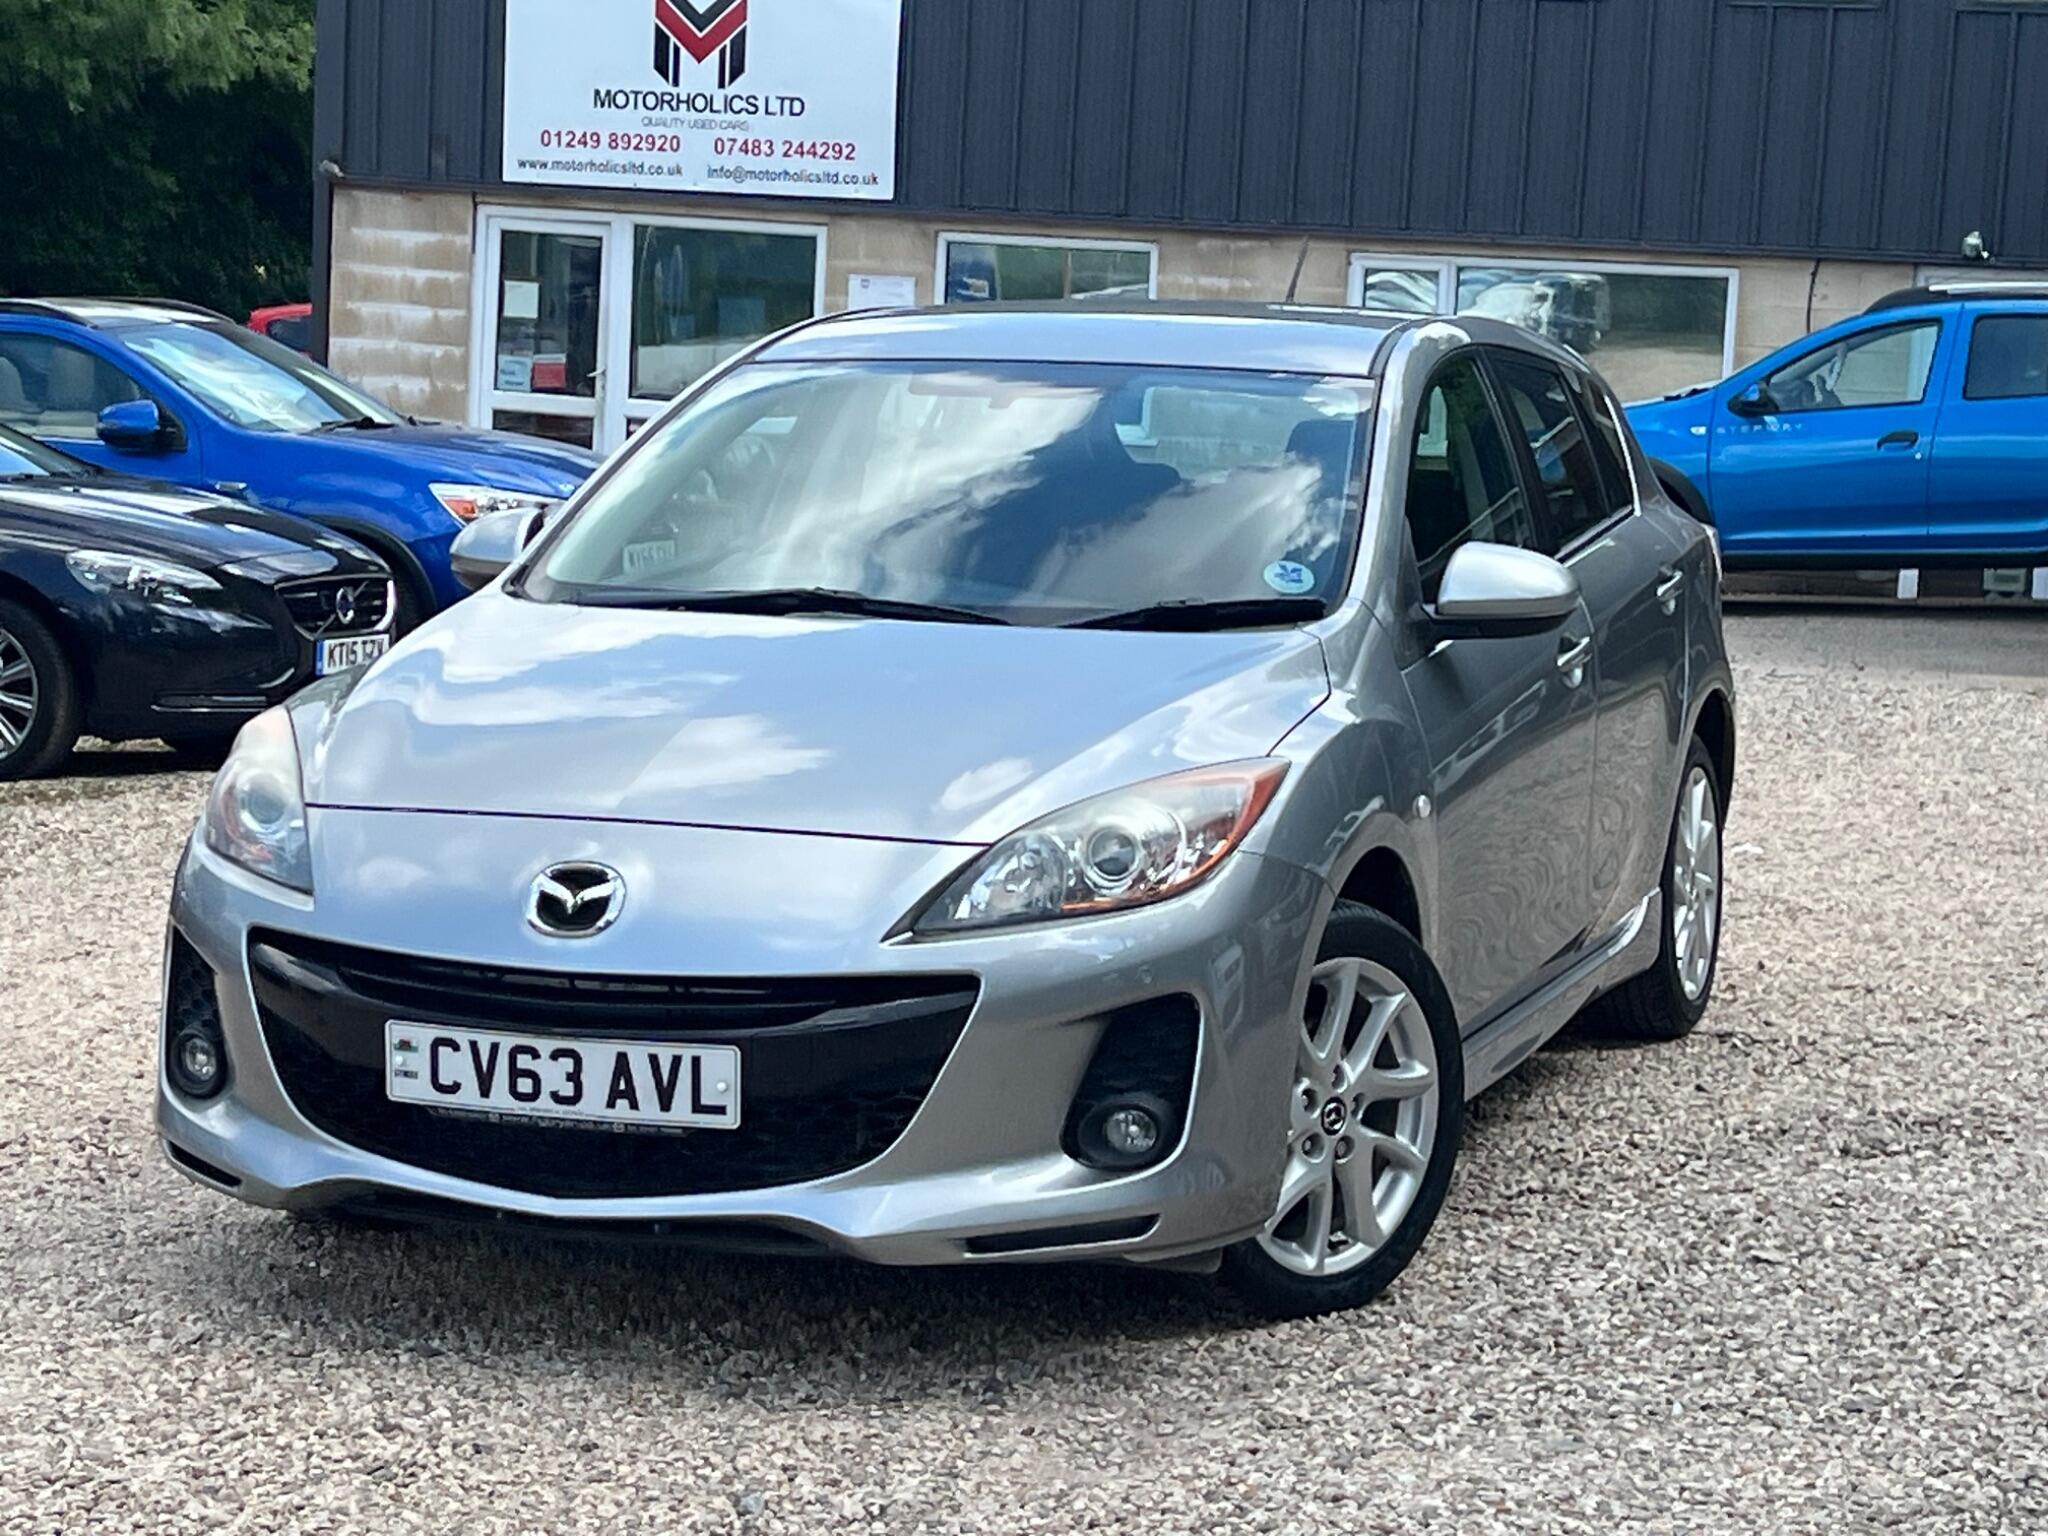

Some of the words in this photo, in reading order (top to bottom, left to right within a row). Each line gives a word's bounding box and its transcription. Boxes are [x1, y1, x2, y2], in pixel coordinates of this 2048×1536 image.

[593, 88, 760, 115] MOTORHOLICS
[764, 95, 806, 117] LTD
[641, 115, 684, 129] QUALITY
[688, 118, 718, 131] USED
[719, 119, 750, 132] CARS
[540, 129, 601, 150] 01249
[607, 131, 681, 153] 892920
[713, 136, 775, 158] 07483
[781, 139, 857, 161] 244292
[516, 158, 683, 177] www.motorholicsltd.co.uk
[706, 164, 879, 186] info@motorholicsltd.co.uk
[327, 640, 359, 669] KT15
[429, 1035, 584, 1107] CV63
[605, 1050, 728, 1117] AVL
